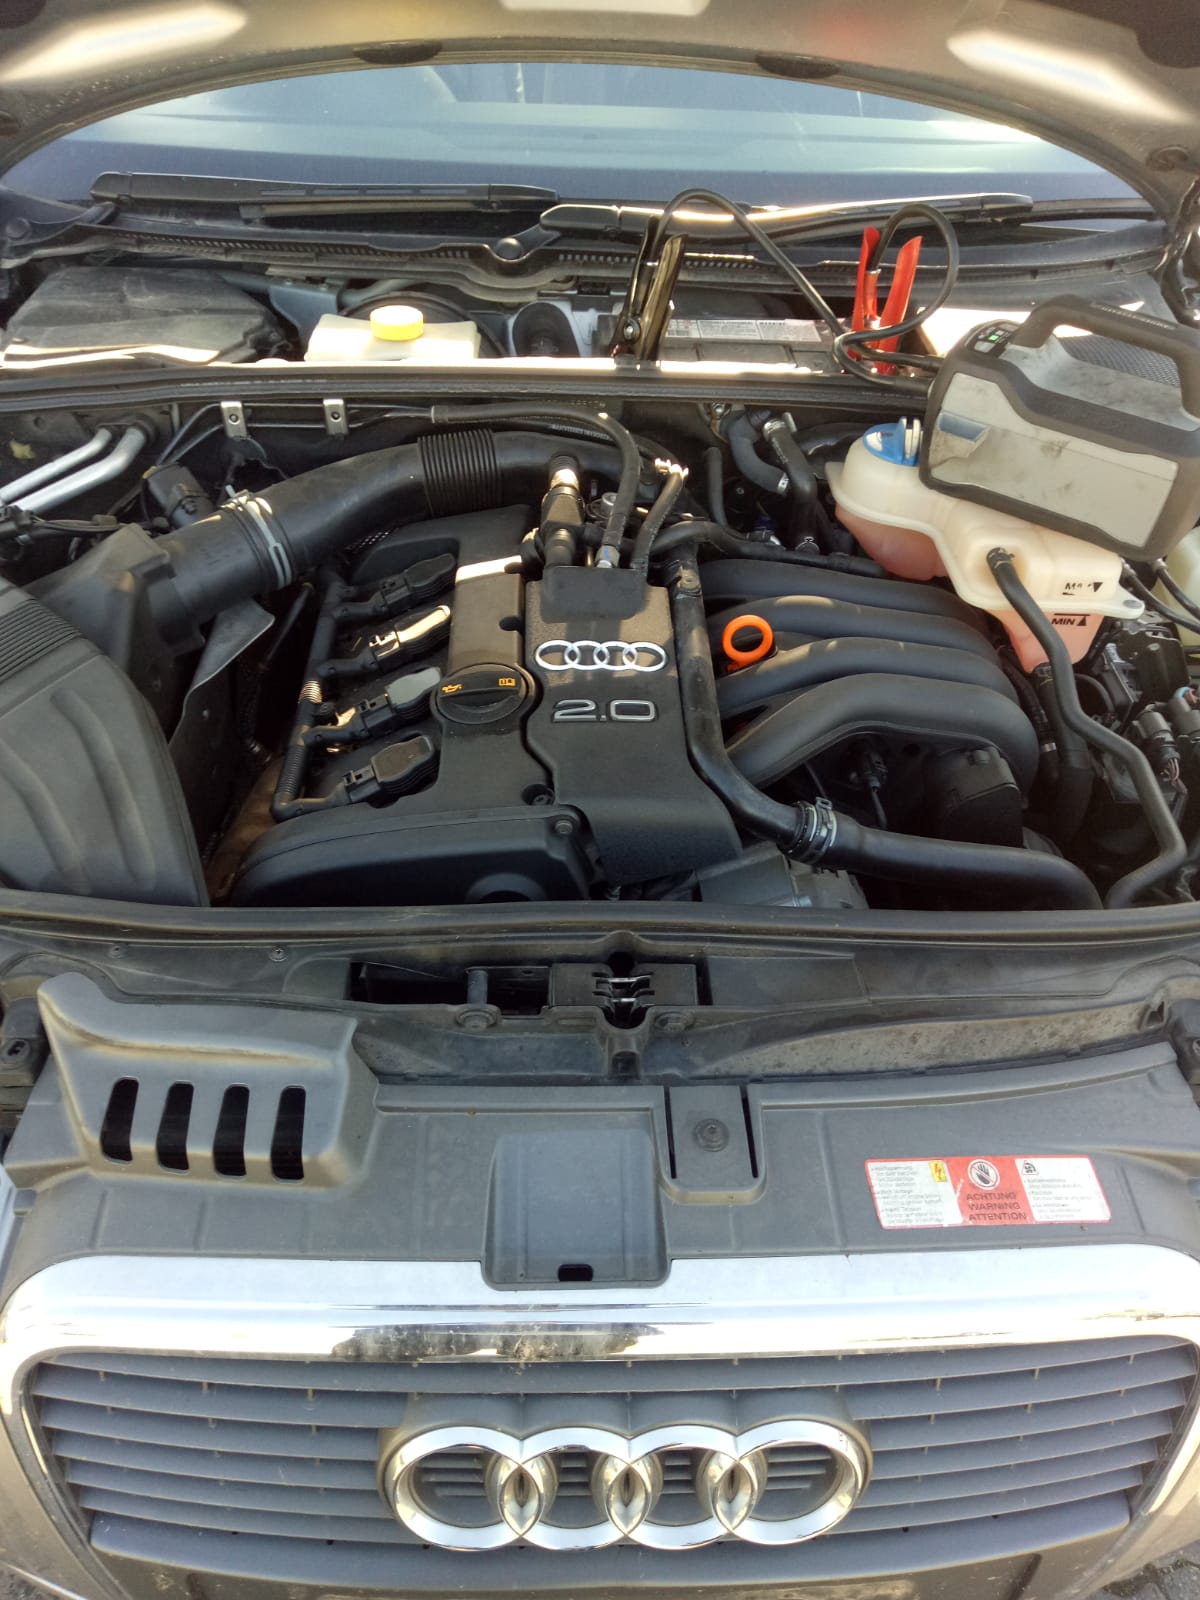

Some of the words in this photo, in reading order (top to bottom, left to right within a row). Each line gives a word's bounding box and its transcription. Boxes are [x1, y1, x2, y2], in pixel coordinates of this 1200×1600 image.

[1051, 617, 1076, 625] MIN
[553, 699, 656, 721] 2.0
[966, 1192, 1017, 1201] ACHTUNG
[968, 1202, 1020, 1211] WARNING
[969, 1212, 1027, 1221] ATTENTION
